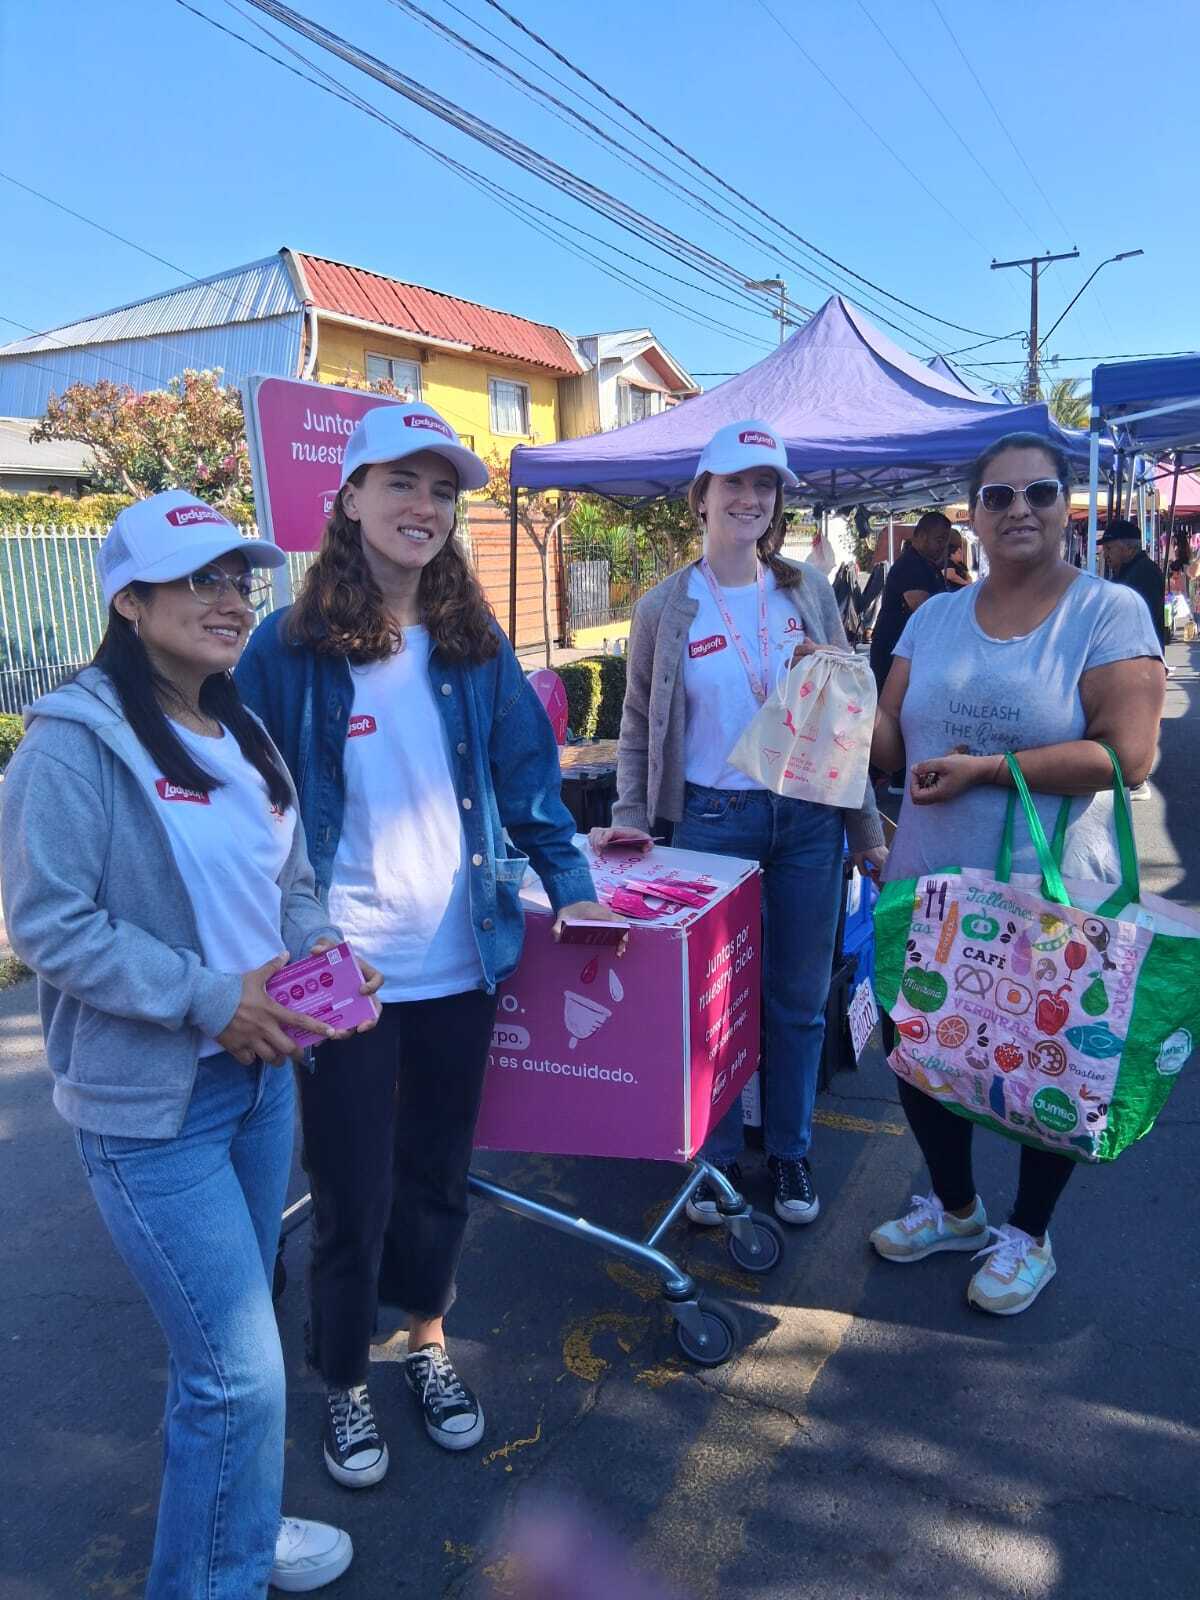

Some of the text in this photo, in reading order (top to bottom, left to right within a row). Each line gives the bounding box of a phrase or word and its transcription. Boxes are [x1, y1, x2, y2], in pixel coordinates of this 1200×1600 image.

[690, 636, 724, 657] Ladysoft
[949, 701, 1021, 722] UNLEASH
[943, 720, 972, 739] THE
[706, 925, 751, 979] Juntas por
[962, 946, 1007, 970] CAFÉ
[699, 966, 733, 1012] nuestro
[499, 1056, 519, 1069] es
[522, 1058, 639, 1085] autocuidado.
